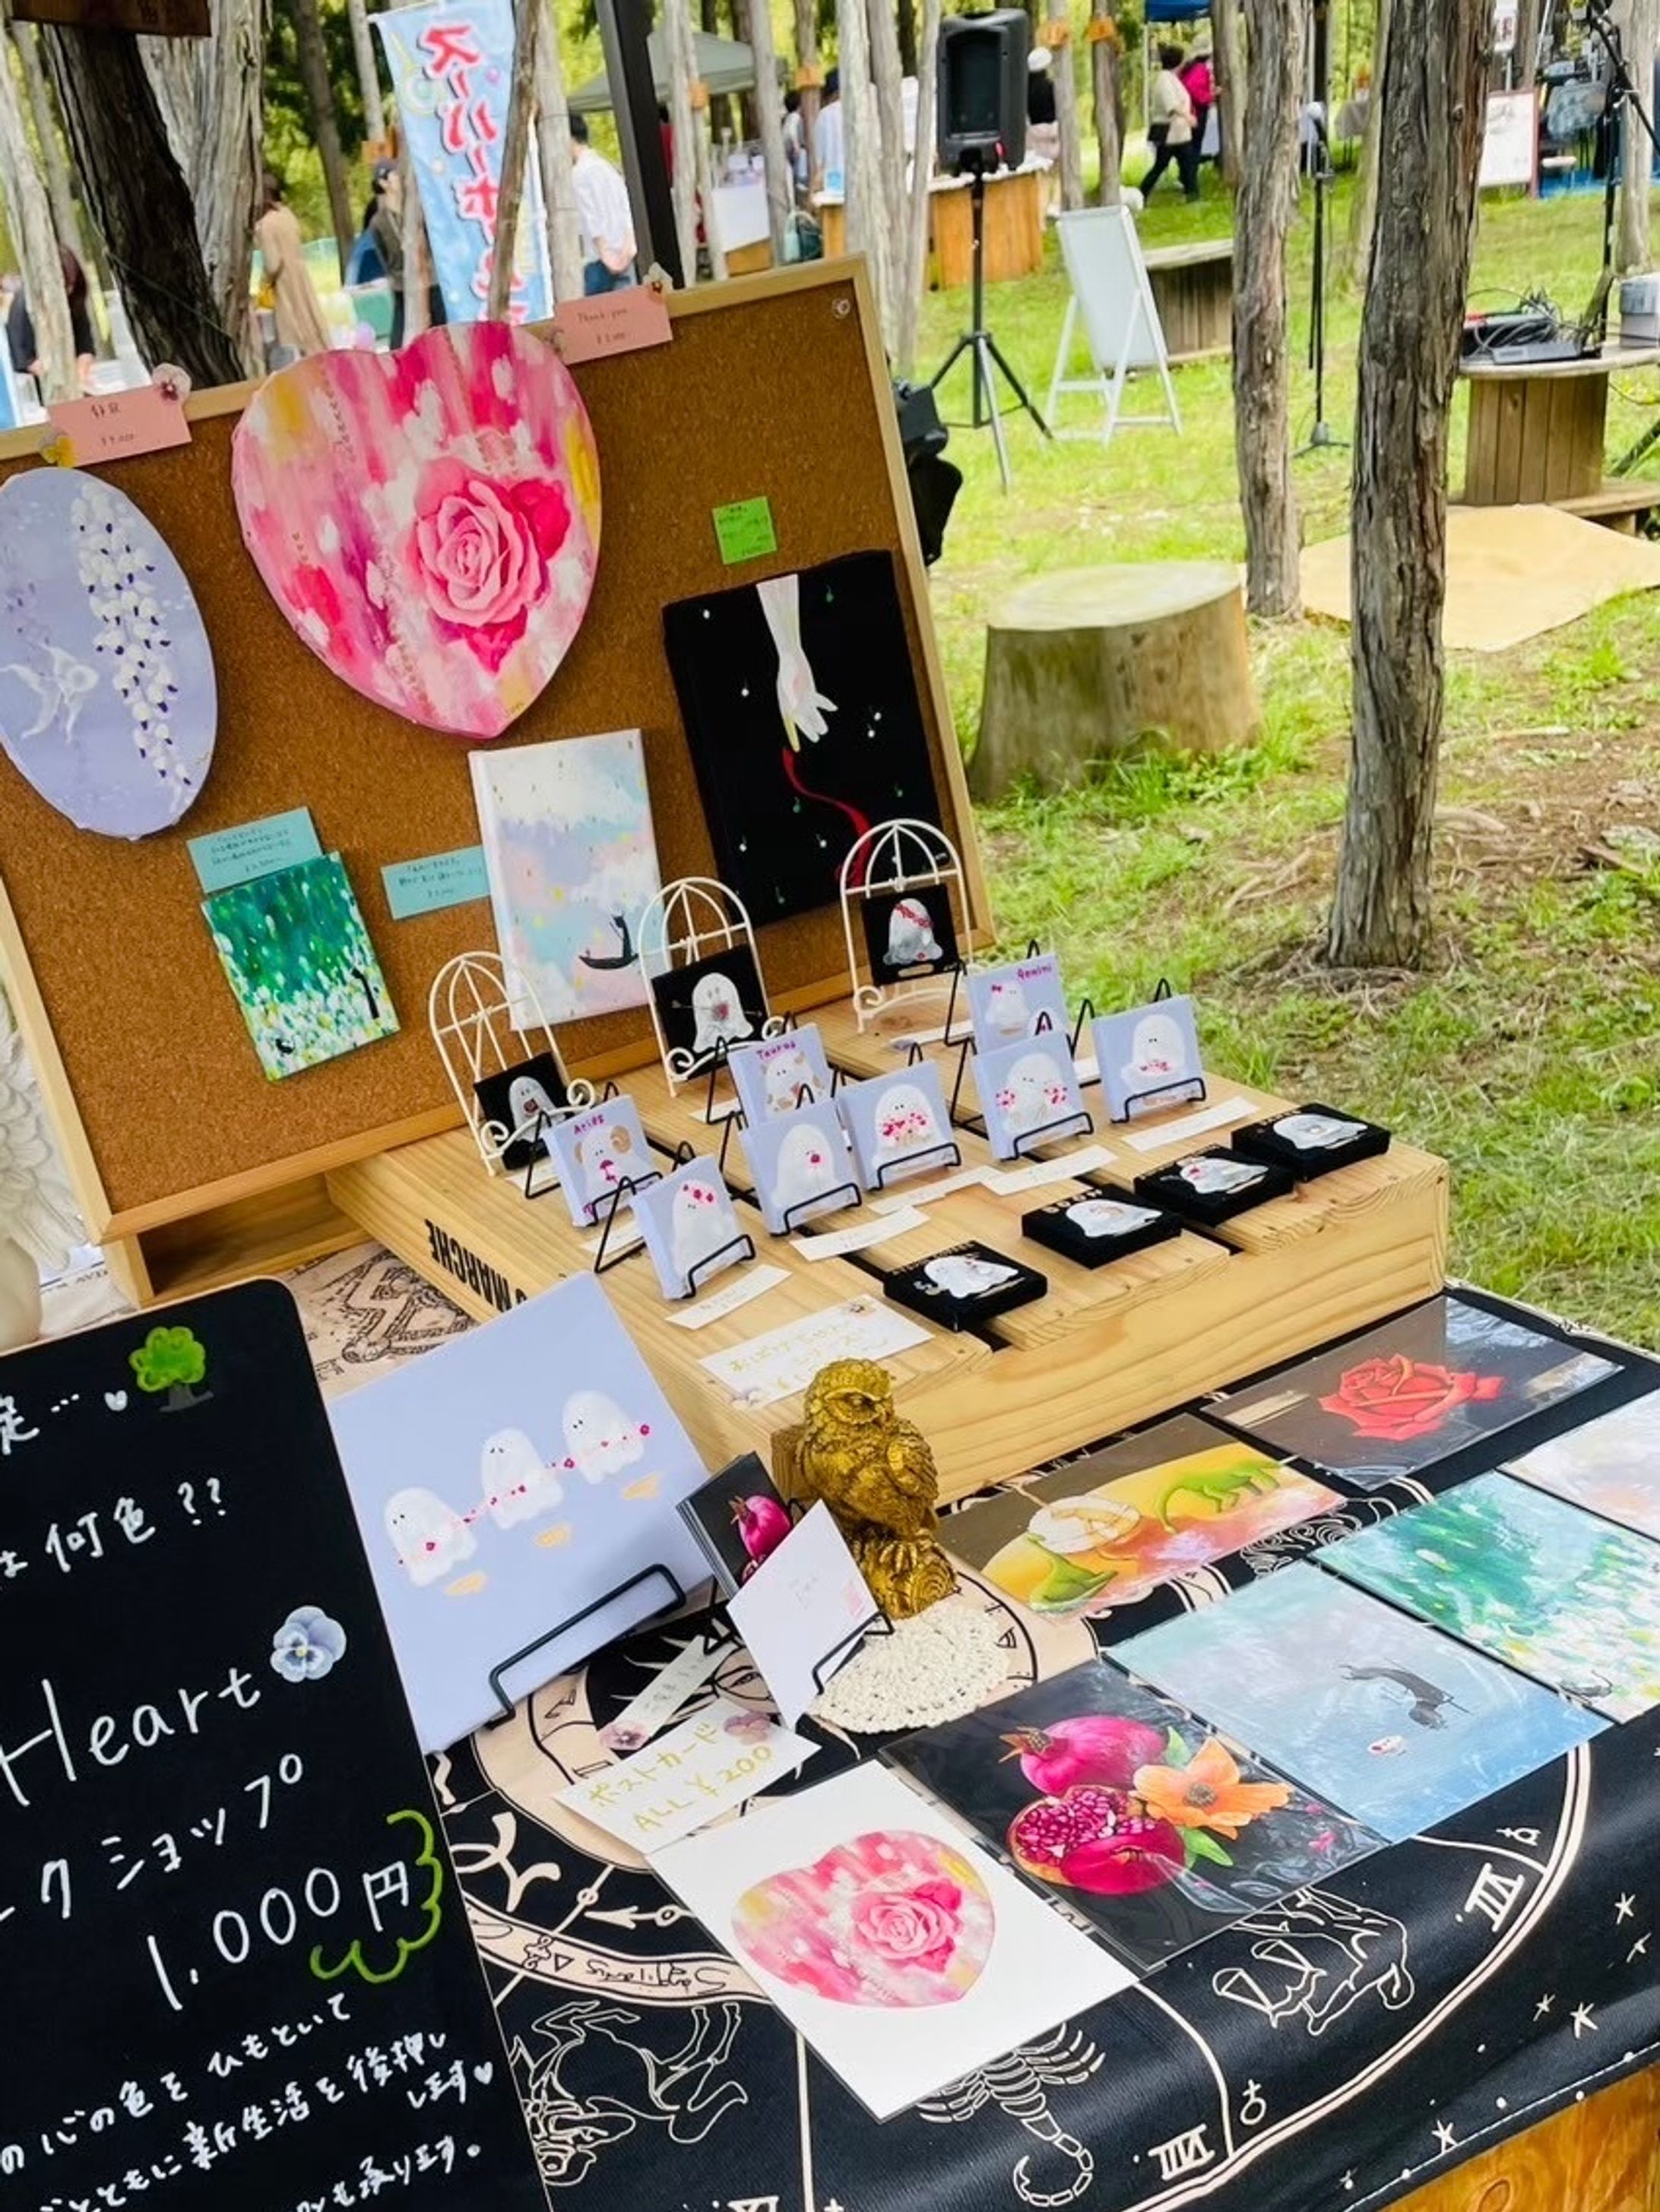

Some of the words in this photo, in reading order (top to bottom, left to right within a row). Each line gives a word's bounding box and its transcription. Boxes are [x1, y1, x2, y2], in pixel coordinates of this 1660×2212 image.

[423, 1218, 512, 1313] MARCHE
[0, 1667, 261, 1807] Heart
[633, 1797, 695, 1832] ALL
[686, 1743, 774, 1798] ¥200
